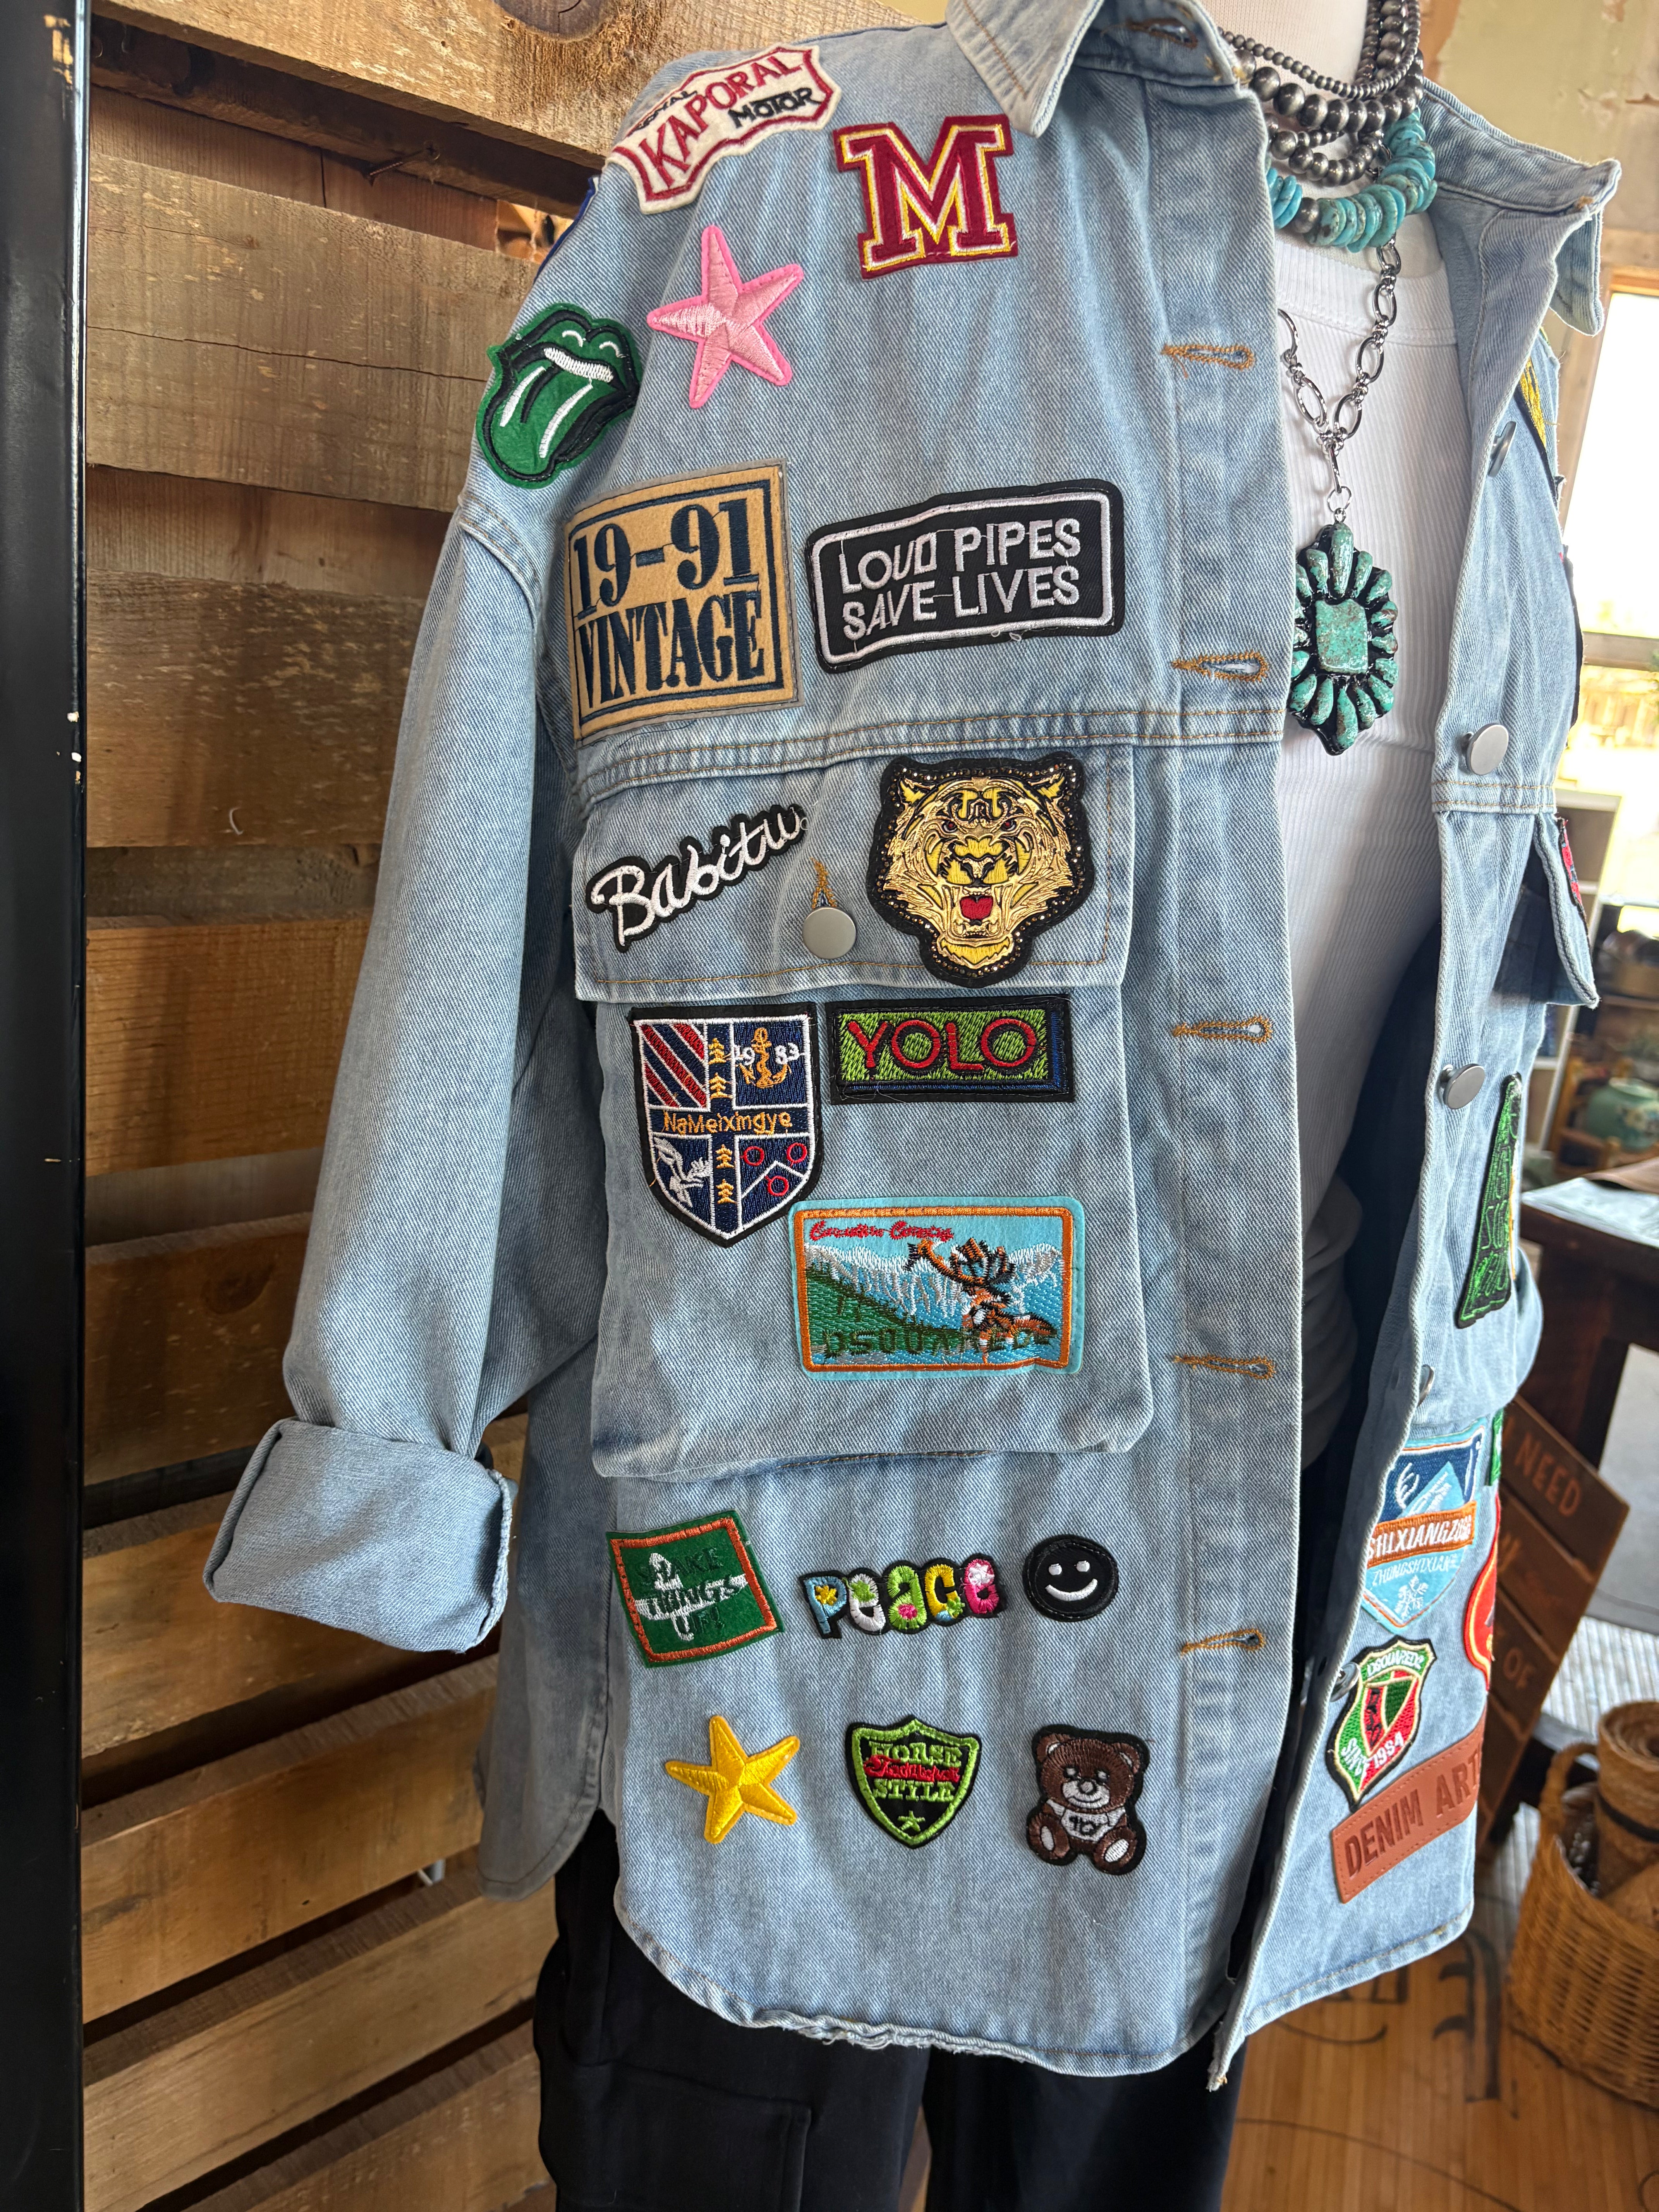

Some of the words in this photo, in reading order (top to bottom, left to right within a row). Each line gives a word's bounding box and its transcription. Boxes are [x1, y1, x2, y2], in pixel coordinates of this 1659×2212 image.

[638, 56, 803, 189] KAPORAL
[727, 87, 823, 128] MOTOR
[836, 121, 1014, 273] M
[572, 500, 760, 617] 19-91
[838, 531, 937, 594] LOUD
[954, 517, 1081, 572] PIPES
[842, 580, 937, 641] SAVE
[952, 565, 1080, 617] LIVES
[577, 591, 764, 709] VINTAGE
[847, 1018, 1038, 1072] YOLO
[1515, 1434, 1582, 1517] NEED
[803, 1558, 1000, 1635] peace
[1503, 1647, 1536, 1689] OF
[869, 1740, 963, 1768] HORSE
[872, 1778, 955, 1802] STYLE
[1344, 1788, 1424, 1880] DENIM
